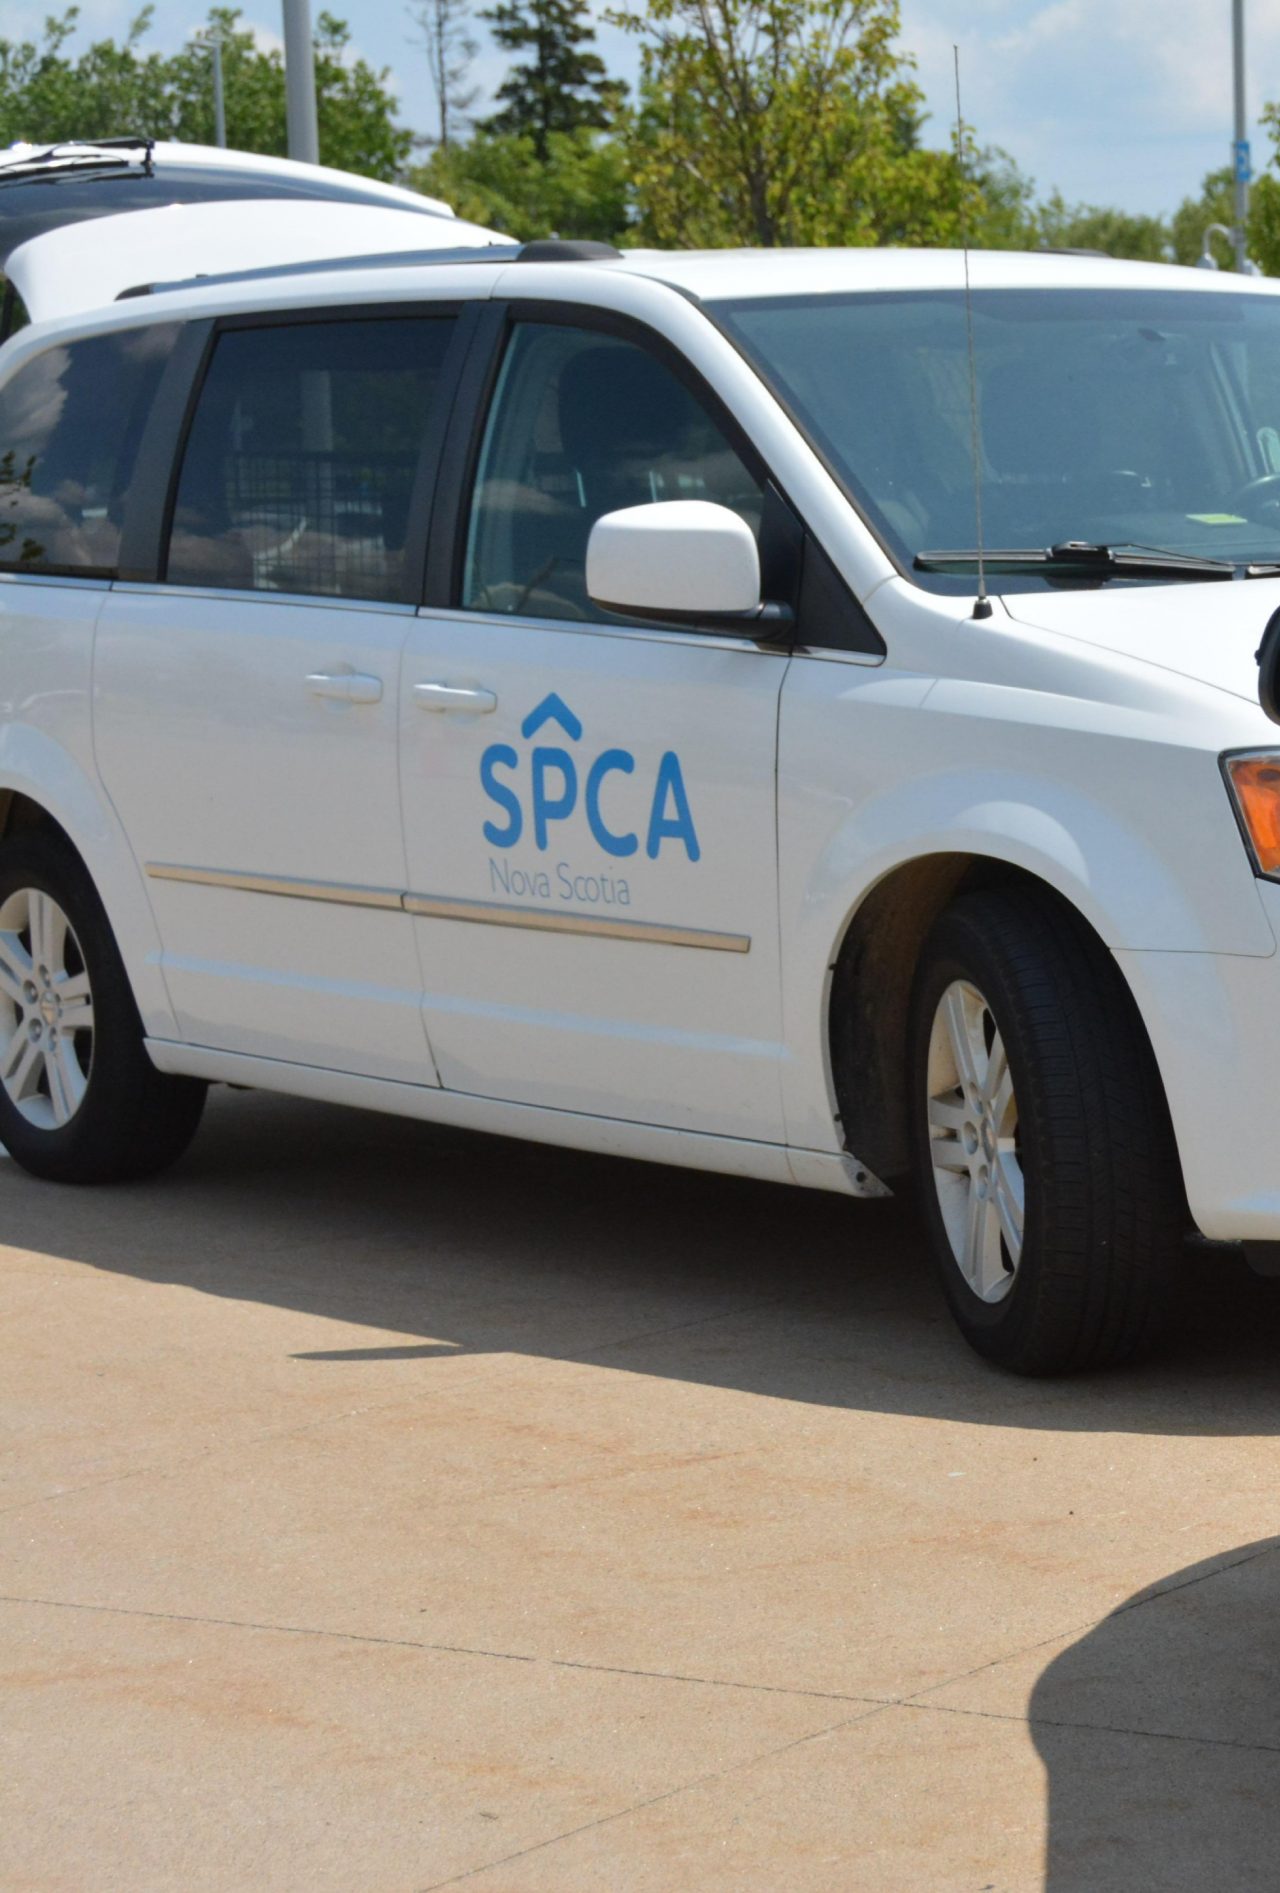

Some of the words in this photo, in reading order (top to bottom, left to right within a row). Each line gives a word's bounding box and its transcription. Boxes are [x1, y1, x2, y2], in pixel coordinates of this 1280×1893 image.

[480, 743, 701, 862] SPCA
[488, 857, 551, 898] Nova
[556, 862, 631, 905] Scotia
